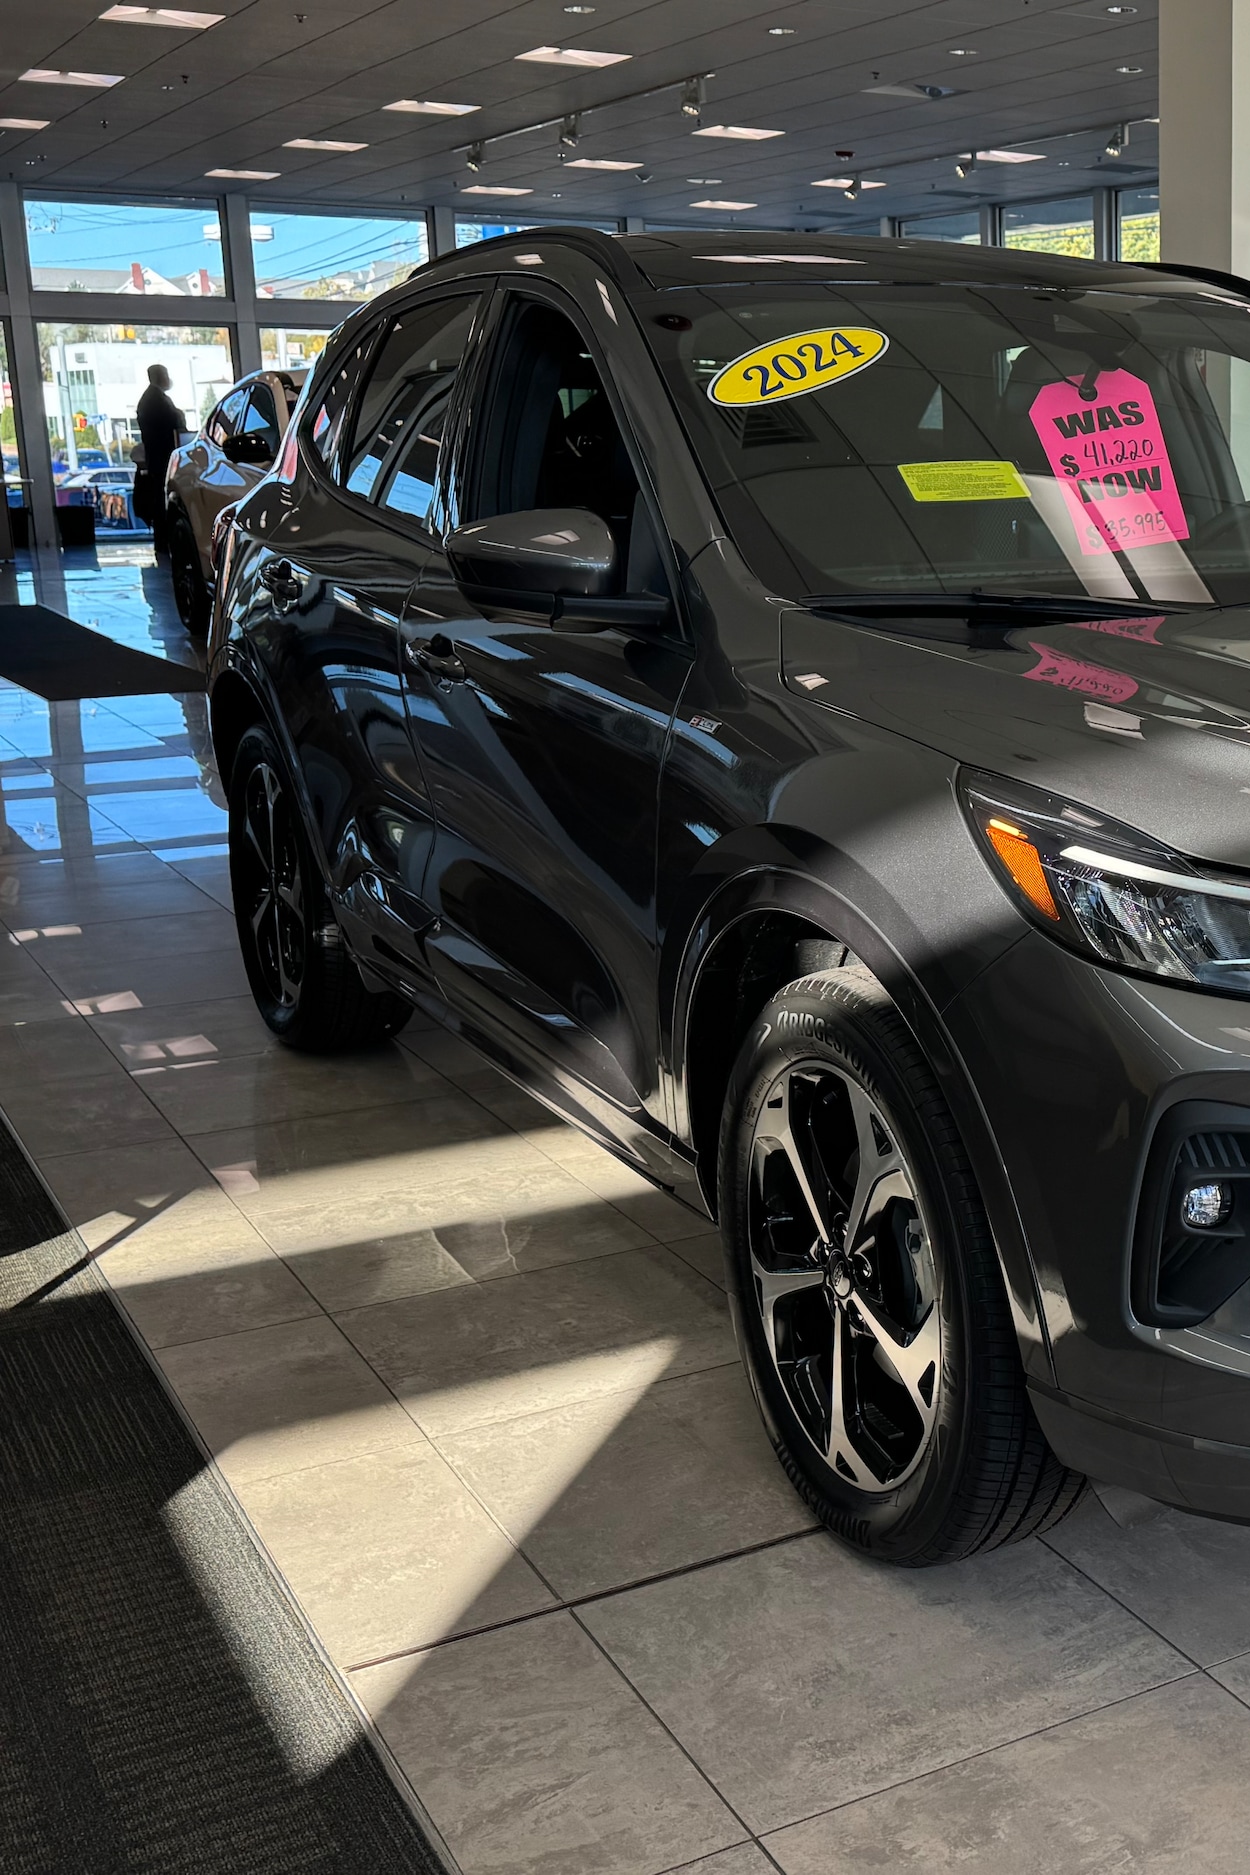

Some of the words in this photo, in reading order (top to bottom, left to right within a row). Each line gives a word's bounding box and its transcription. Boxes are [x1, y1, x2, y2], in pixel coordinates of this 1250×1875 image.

[743, 332, 865, 397] 2024
[1052, 401, 1145, 439] WAS
[1059, 453, 1080, 477] $
[1084, 439, 1154, 467] 41,220
[1077, 466, 1162, 503] NOW
[1086, 524, 1104, 549] $
[777, 1010, 881, 1100] BRIDGESTONE
